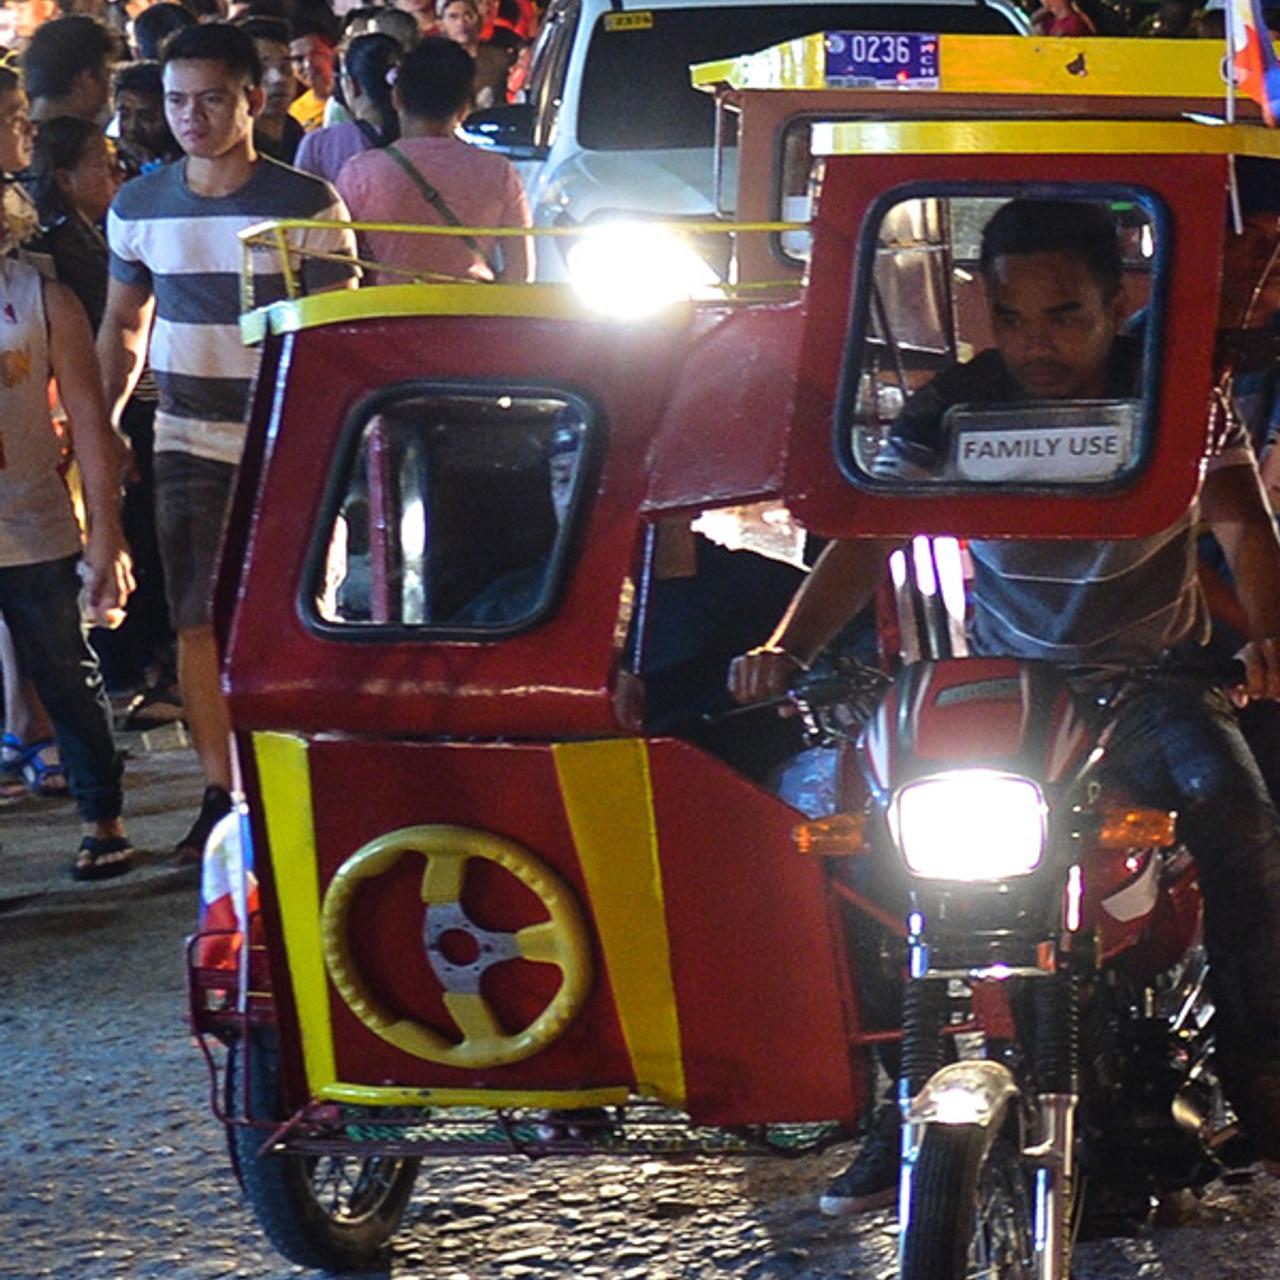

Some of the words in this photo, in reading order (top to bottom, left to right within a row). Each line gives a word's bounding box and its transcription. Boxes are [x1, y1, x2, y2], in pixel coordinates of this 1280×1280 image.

[852, 35, 910, 63] 0236
[962, 436, 1061, 461] FAMILY
[1069, 434, 1119, 457] USE
